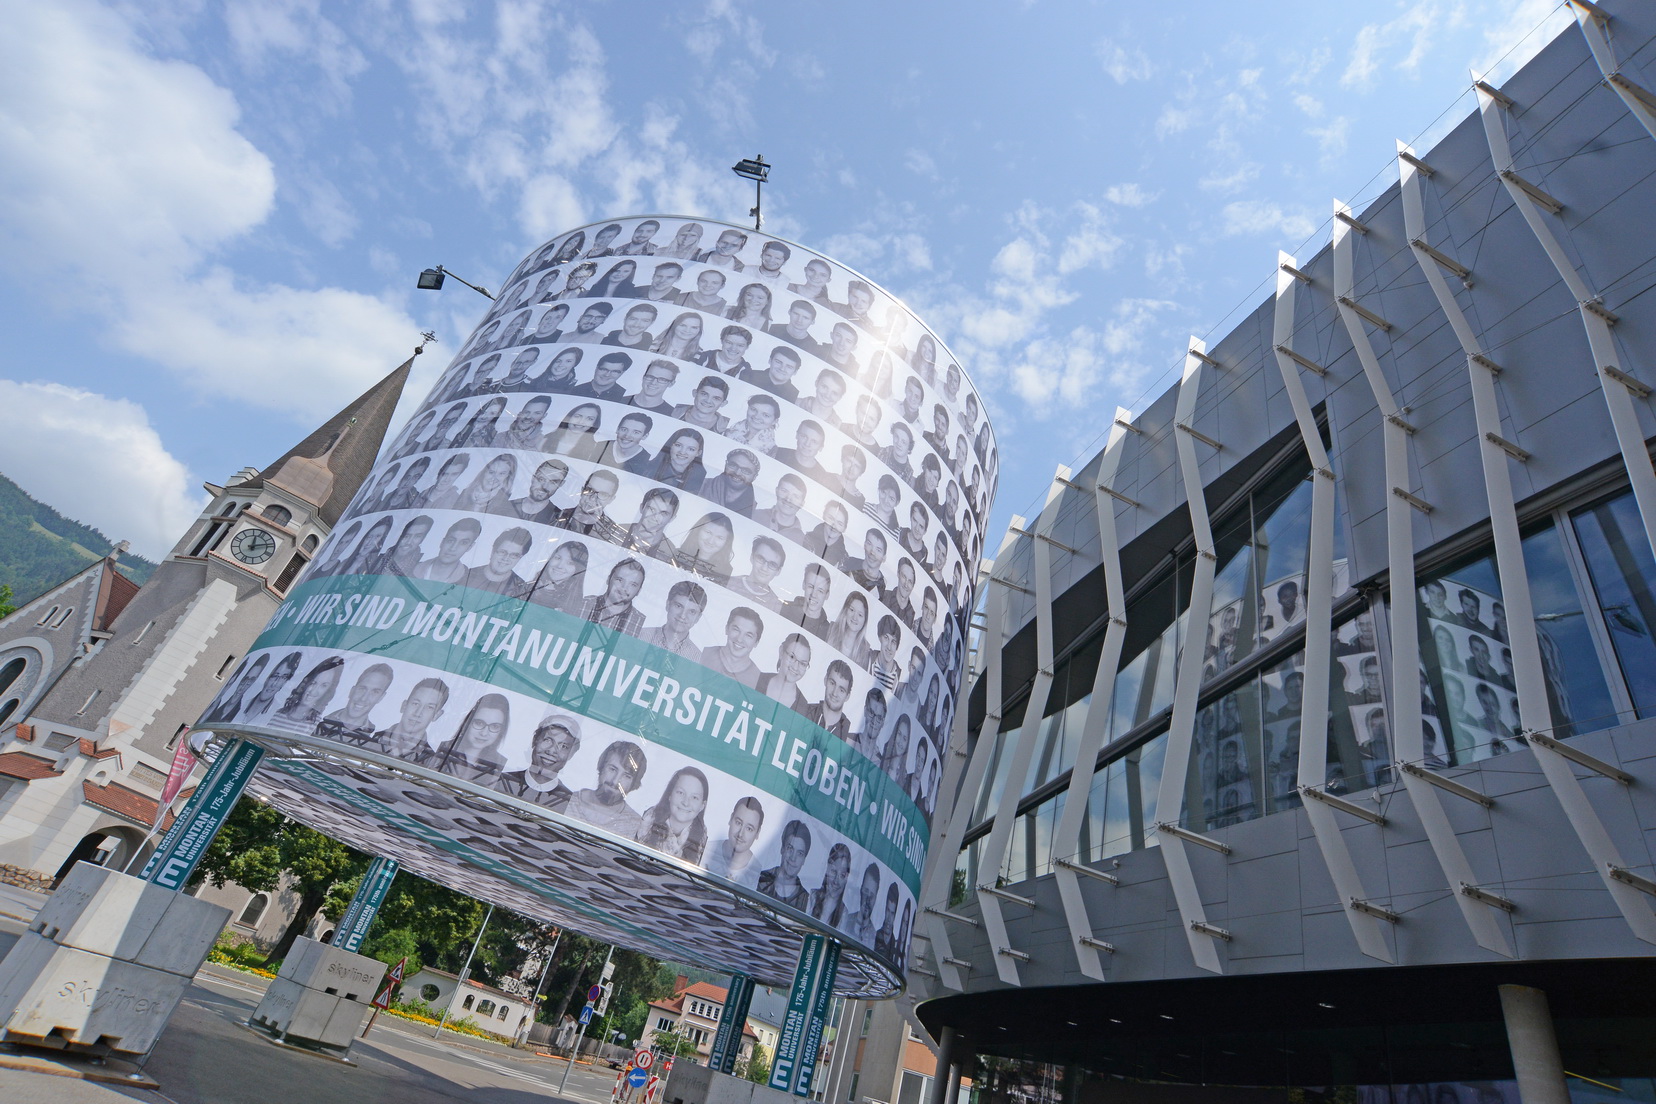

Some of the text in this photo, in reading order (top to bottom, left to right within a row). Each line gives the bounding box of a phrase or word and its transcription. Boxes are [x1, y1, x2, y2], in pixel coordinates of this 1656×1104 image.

[294, 593, 338, 624] WIR
[337, 593, 405, 630] SIND
[402, 601, 772, 756] MONTANUNIVERSITÄT
[771, 729, 866, 815] LEOBEN
[881, 799, 907, 852] WIR
[906, 826, 924, 874] SIND
[210, 748, 256, 811] 175-Jahr-Jubiläum
[159, 807, 191, 849] MONTAN
[174, 812, 210, 858] MONTAN
[186, 816, 218, 861] UNIVERSITÄT
[354, 904, 372, 933] MONTAN
[371, 890, 381, 903] 175th
[328, 963, 374, 985] skyliner
[795, 940, 817, 1006] 175-Jahr-Jubiläum
[818, 945, 838, 1012] 175th anniversary
[715, 1022, 727, 1051] MONTAN
[779, 1010, 797, 1057] MONTAN
[788, 1012, 804, 1059] UNIVERSITÄT
[803, 1016, 819, 1063] MONTAN
[809, 1019, 823, 1065] UNIVERSITÄT
